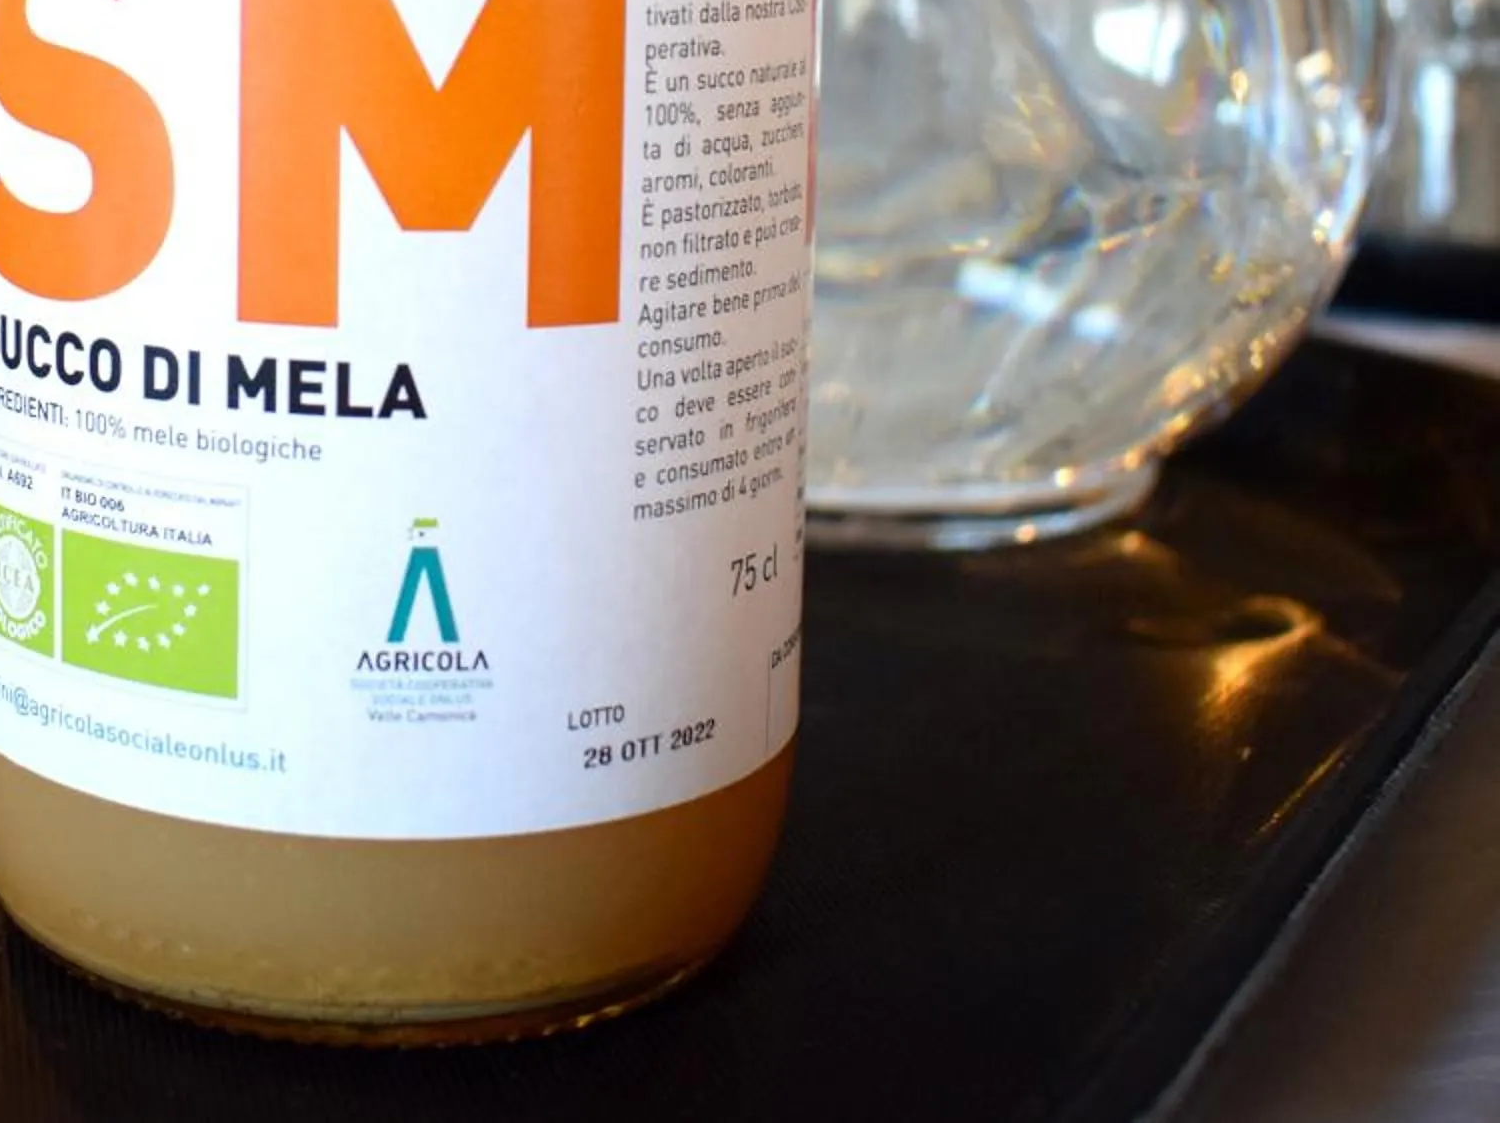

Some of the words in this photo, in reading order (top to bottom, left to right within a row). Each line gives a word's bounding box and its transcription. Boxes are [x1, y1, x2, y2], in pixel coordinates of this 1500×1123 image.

[645, 2, 693, 26] tivati
[699, 0, 740, 24] dalla
[745, 0, 785, 22] nostra
[645, 39, 724, 66] perativa.
[666, 75, 689, 92] un
[697, 69, 744, 90] succo
[645, 102, 701, 127] 100%,
[717, 99, 760, 122] senza
[643, 141, 661, 160] ta
[674, 134, 691, 157] di
[701, 132, 753, 157] acqua,
[642, 169, 703, 194] aromi,
[641, 197, 654, 227] È
[661, 194, 764, 229] pastorizzato,
[640, 239, 676, 259] non
[682, 228, 739, 255] filtrato
[743, 229, 751, 245] e
[639, 274, 661, 293] re
[666, 259, 757, 291] sedimento.
[638, 300, 707, 330] Agitare
[712, 291, 749, 316] bene
[753, 280, 787, 312] prima
[637, 329, 726, 358] consumo.
[143, 344, 201, 406] DI
[226, 354, 427, 420] MELA
[637, 368, 676, 391] Una
[681, 359, 722, 385] volta
[725, 349, 769, 379] aperto
[635, 405, 659, 424] co
[675, 395, 715, 419] deve
[727, 379, 772, 407] essere
[76, 409, 126, 439] 100%
[133, 422, 188, 449] mele
[197, 428, 322, 463] biologiche
[634, 428, 705, 457] servato
[719, 421, 734, 442] in
[634, 471, 645, 489] e
[656, 448, 748, 486] consumato
[753, 433, 783, 461] entro
[61, 486, 71, 500] IT
[75, 489, 97, 509] BIO
[100, 496, 125, 512] 006
[633, 489, 717, 521] massimo
[721, 479, 735, 502] di
[738, 476, 747, 496] 4
[61, 507, 160, 539] AGRICOLTURA
[163, 526, 213, 546] ITALIA
[731, 552, 757, 597] 75
[762, 541, 778, 583] cl
[356, 650, 490, 672] AGRICOLA
[367, 708, 402, 722] Valle
[567, 704, 625, 731] LOTTO
[583, 745, 613, 769] 28
[621, 732, 662, 762] OTT
[670, 717, 716, 751] 2022
